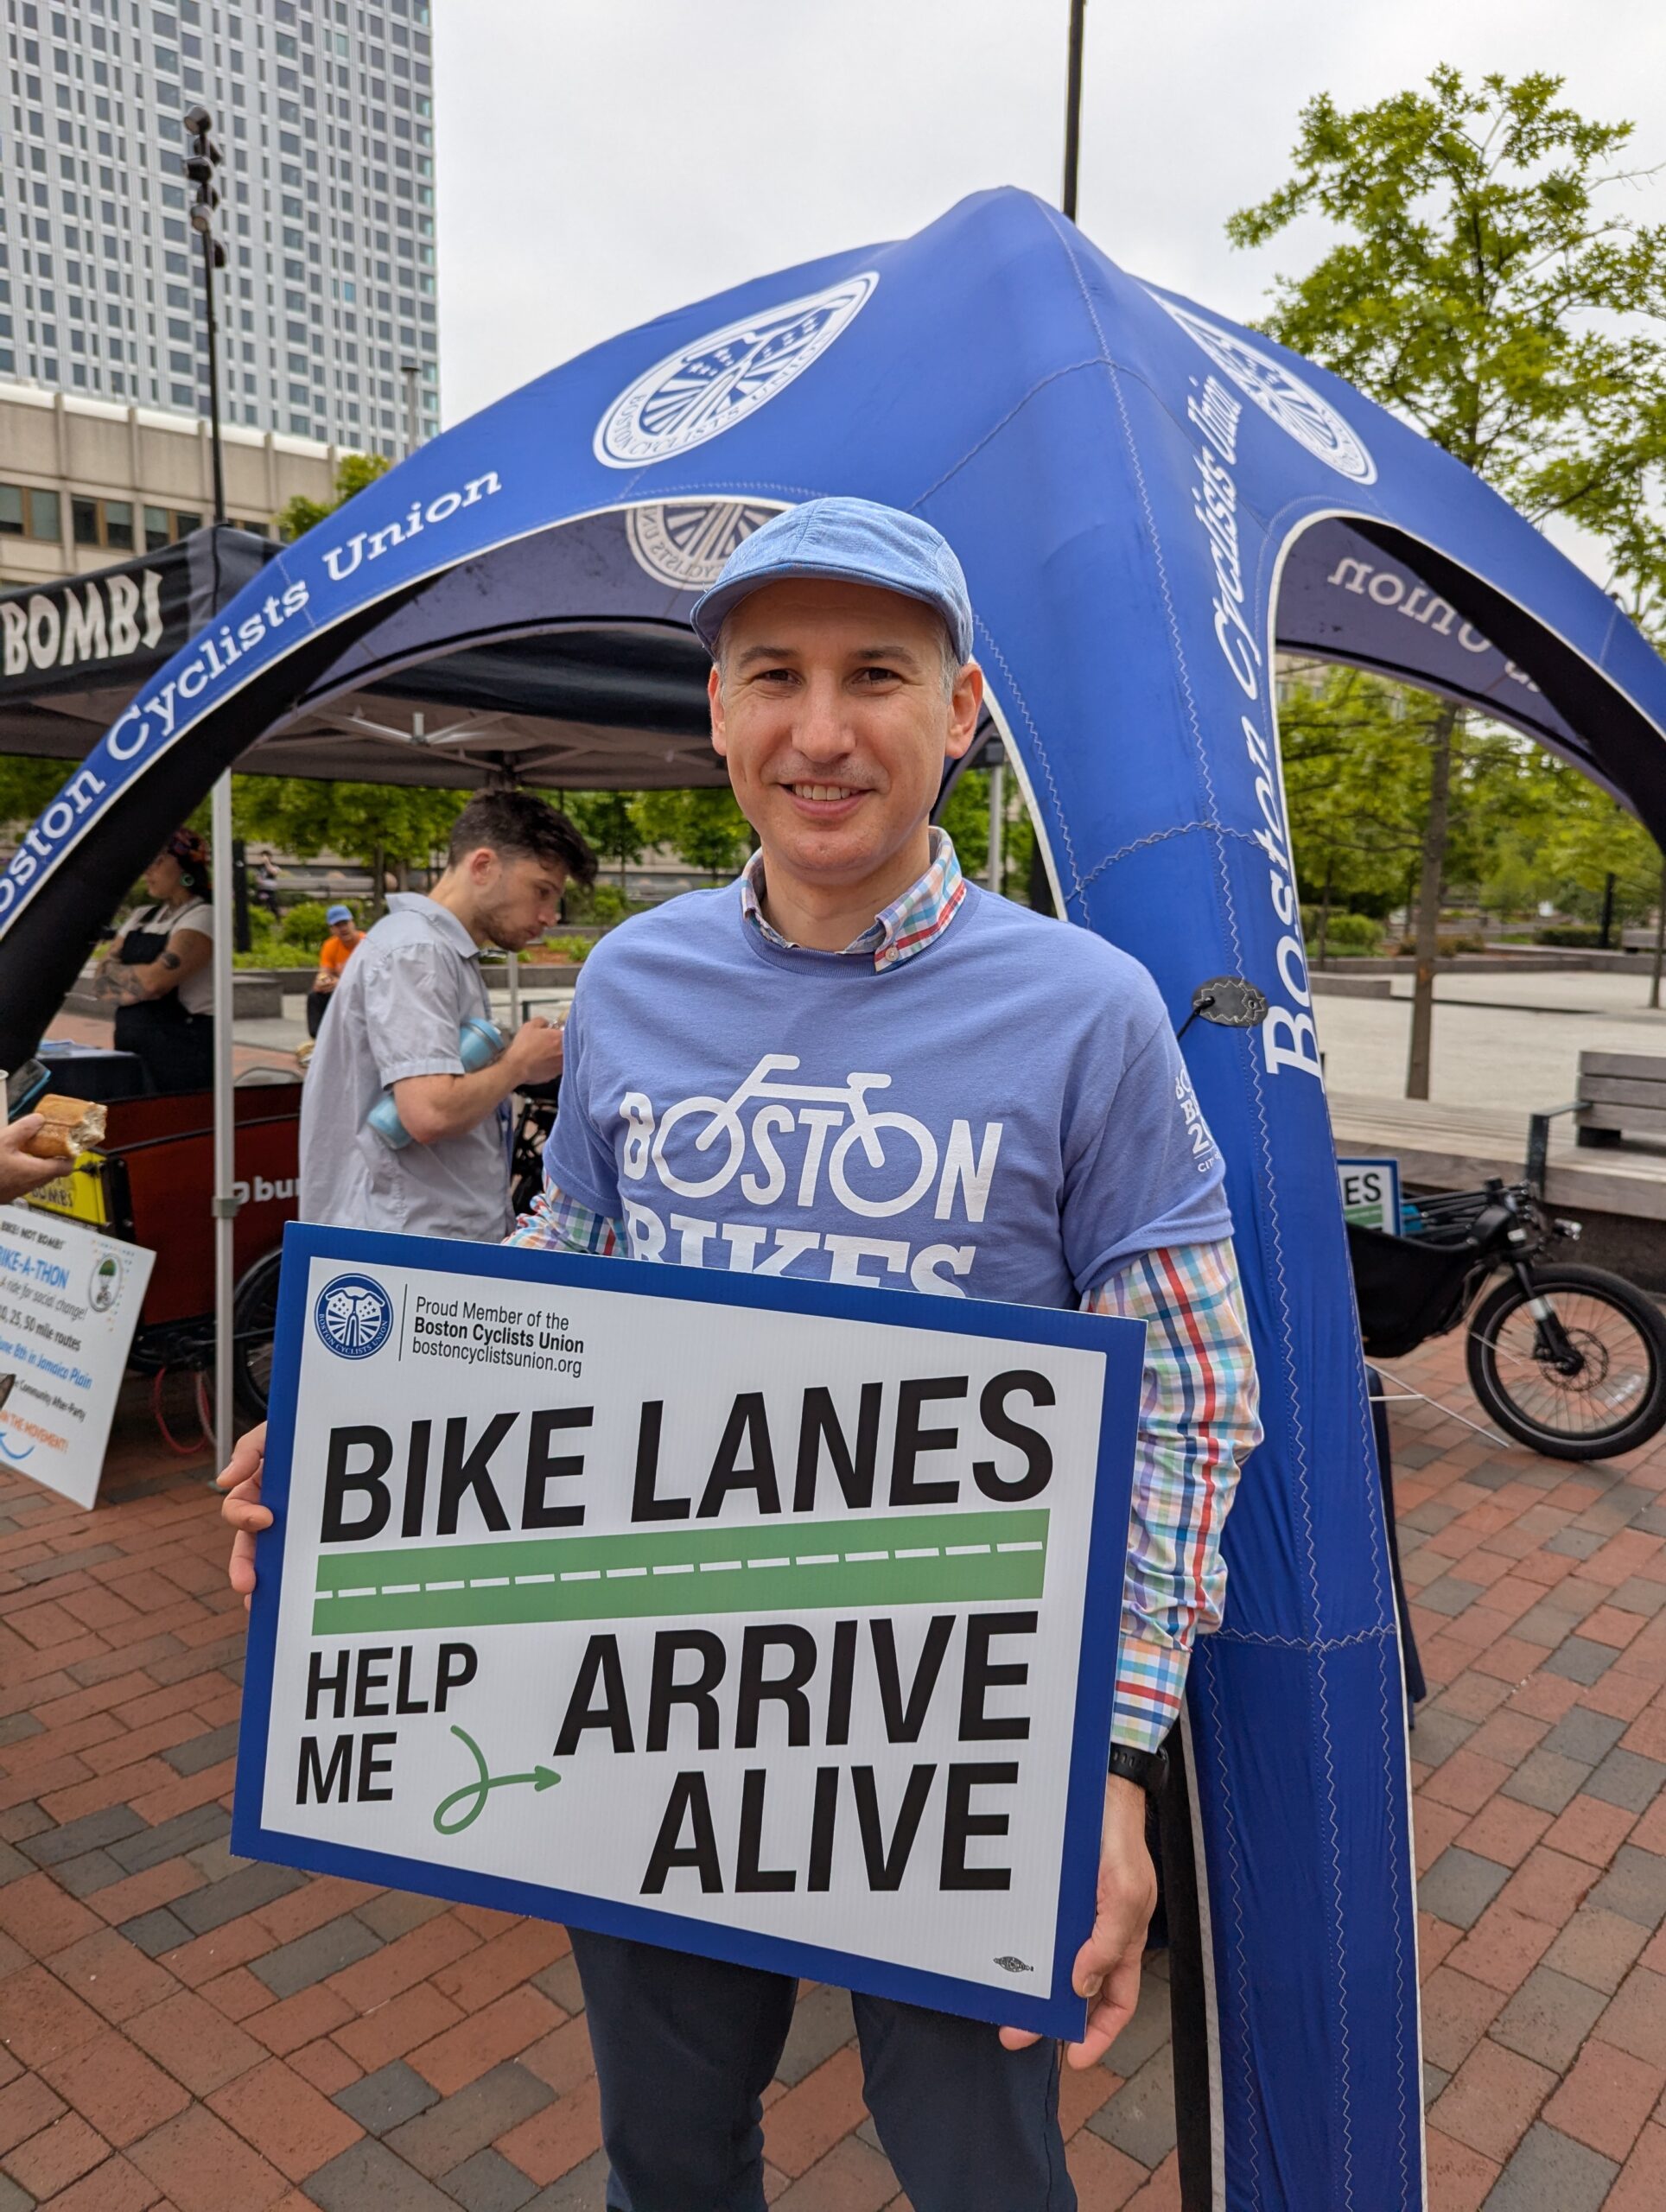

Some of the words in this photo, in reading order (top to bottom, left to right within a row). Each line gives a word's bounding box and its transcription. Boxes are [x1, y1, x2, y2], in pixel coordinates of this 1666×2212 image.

[1192, 445, 1262, 700] Cyclists
[106, 577, 309, 761] Cyclists
[322, 471, 502, 582] Union
[620, 1090, 1003, 1223] BOSTON
[10, 1308, 22, 1329] 25,
[23, 1314, 36, 1332] 50
[35, 1322, 54, 1339] mile
[54, 1332, 82, 1351] routes
[19, 1281, 33, 1300] for
[33, 1291, 56, 1308] social
[416, 1296, 459, 1318] Proud
[463, 1302, 523, 1325] Member
[527, 1311, 544, 1328] of
[546, 1313, 569, 1332] the
[319, 1314, 335, 1345] BOSTON
[335, 1344, 372, 1355] CYCLISTS
[372, 1320, 388, 1346] UNION
[412, 1336, 582, 1378] bostoncyclistsunion.org
[415, 1317, 467, 1338] Boston
[473, 1323, 534, 1347] Cyclists
[539, 1332, 584, 1353] Union
[320, 1405, 595, 1544] BIKE
[630, 1370, 1056, 1524] LANES
[304, 1643, 478, 1720] HELP
[553, 1611, 1039, 1757] ARRIVE
[296, 1732, 397, 1805] ME
[639, 1761, 1020, 1895] ALIVE
